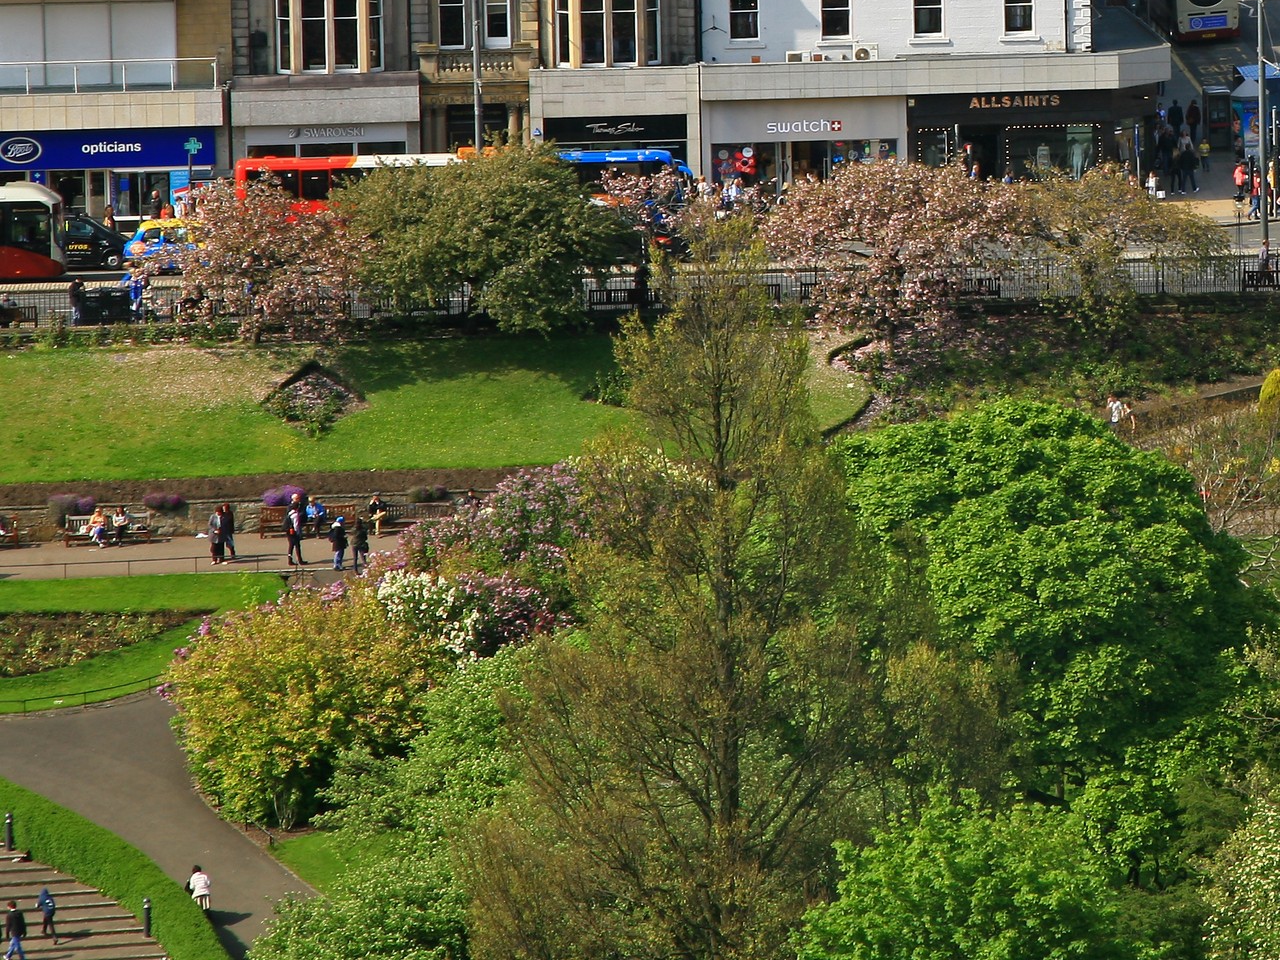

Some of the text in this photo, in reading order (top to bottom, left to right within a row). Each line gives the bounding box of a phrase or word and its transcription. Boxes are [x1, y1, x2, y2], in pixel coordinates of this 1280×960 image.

[969, 95, 1060, 109] ALLSAINTS
[303, 127, 365, 138] SWAROVSKI
[767, 119, 830, 133] swatch
[5, 143, 34, 158] Boots
[81, 142, 142, 155] opticians
